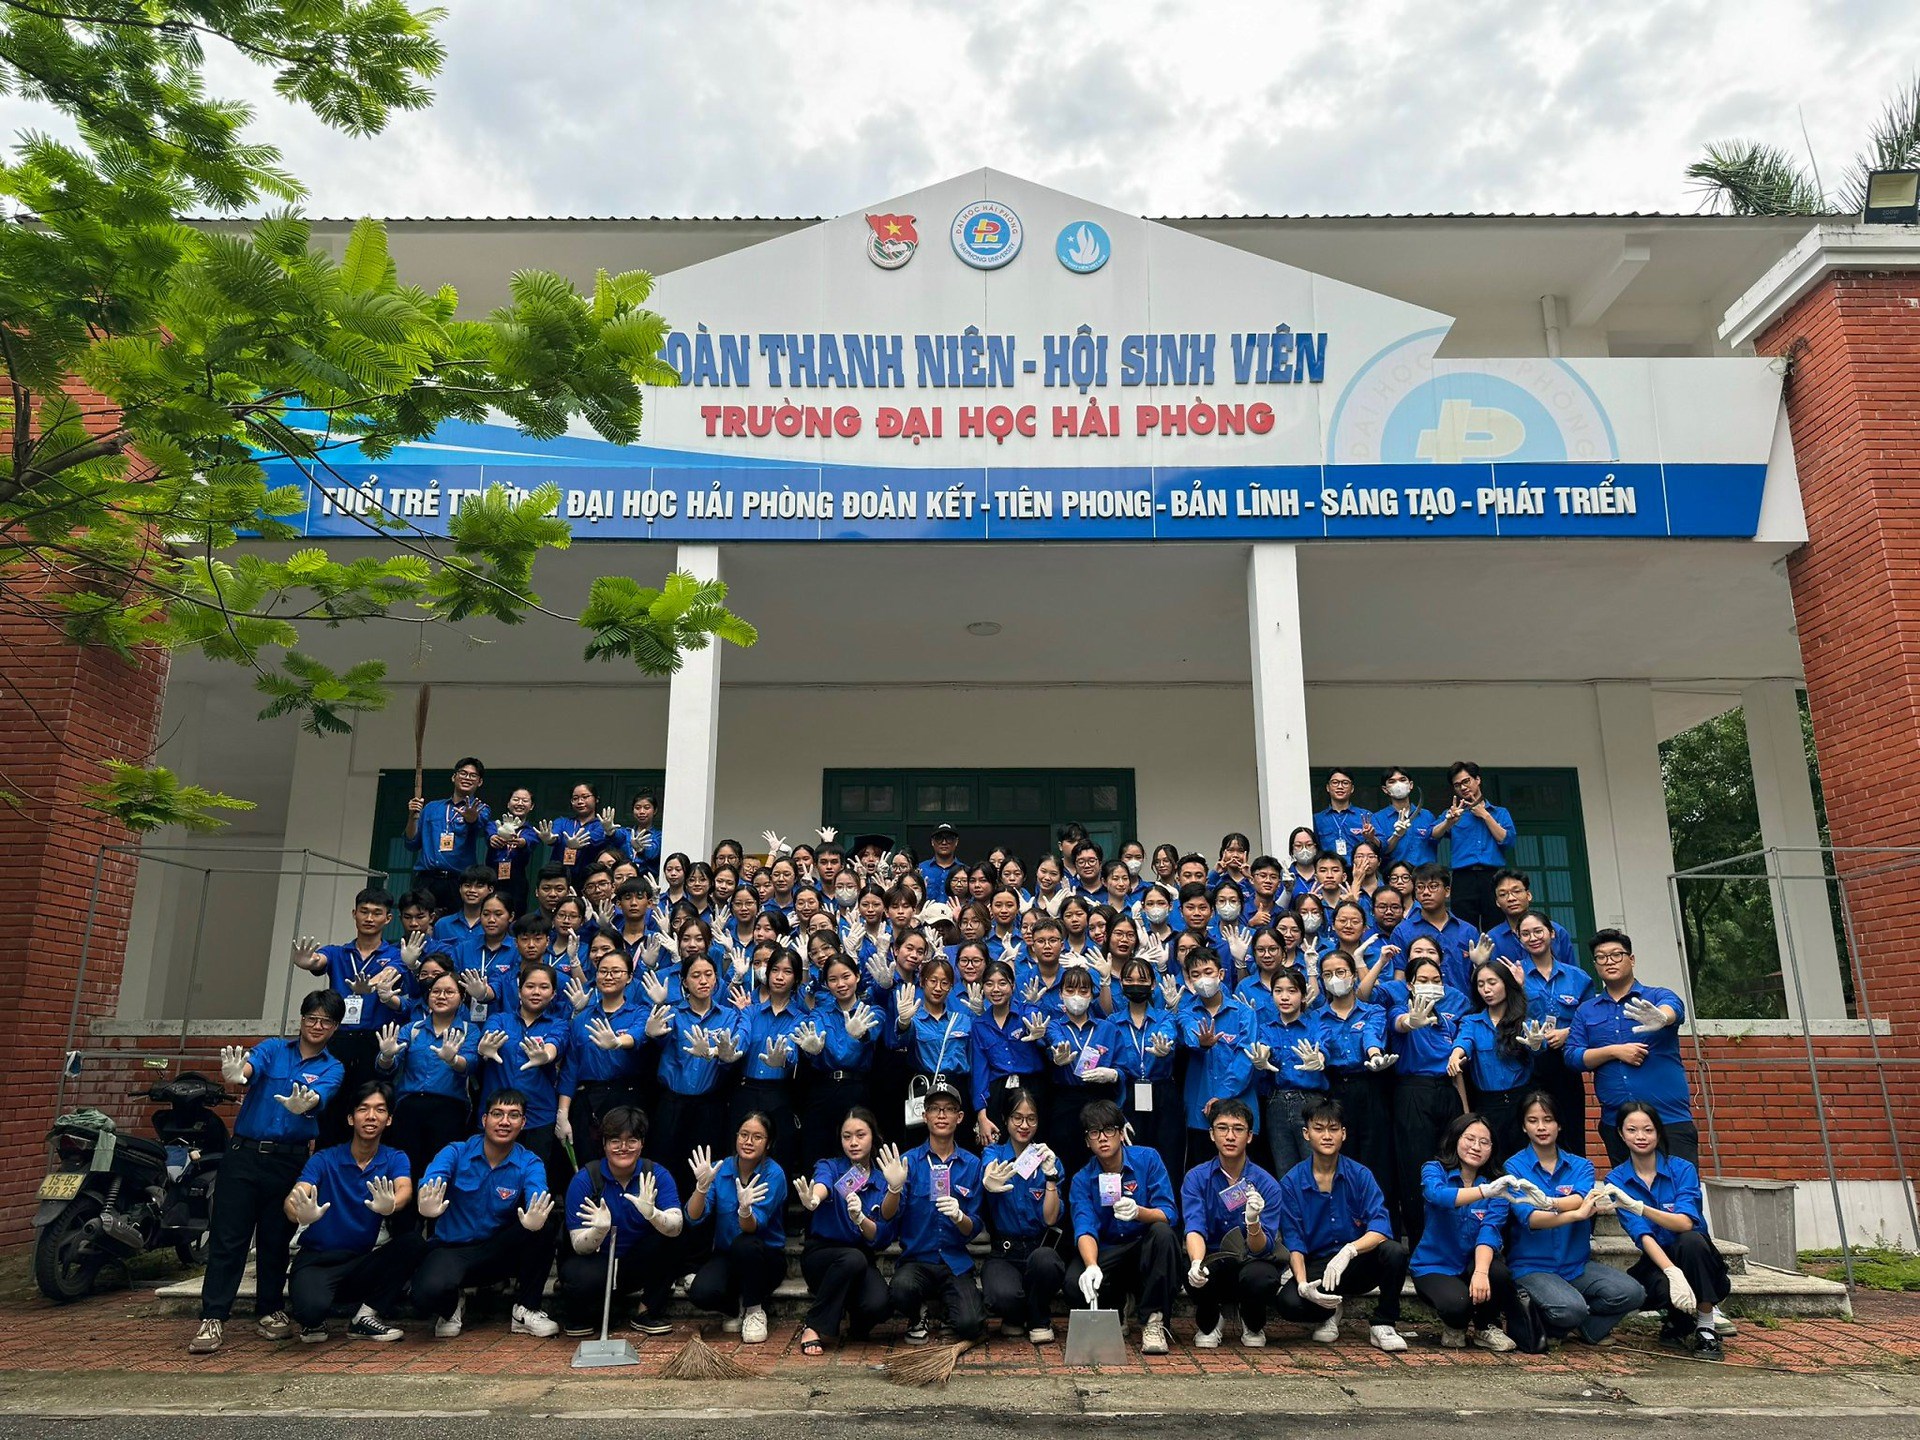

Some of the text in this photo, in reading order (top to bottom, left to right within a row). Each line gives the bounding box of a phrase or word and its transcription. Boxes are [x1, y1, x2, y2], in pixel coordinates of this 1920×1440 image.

[646, 321, 750, 387] OÀN
[759, 333, 905, 388] THANH
[915, 325, 1015, 388] NIÊN
[1043, 323, 1109, 394] HỘI
[1120, 333, 1216, 386] SINH
[1230, 322, 1328, 385] VIÊN
[700, 396, 1276, 445] TRƯỜNG ĐẠI HỌC HẢI PHÒNG
[321, 474, 384, 516] TUỔI
[389, 479, 441, 517] TRẺ
[566, 488, 614, 524] ĐẠI
[622, 489, 677, 523] HỌC
[687, 480, 734, 519] HẢI
[742, 484, 834, 520] PHÒNG
[841, 484, 918, 519] ĐOÀN
[926, 482, 976, 519] KẾT
[994, 485, 1053, 518] TIÊN
[1062, 490, 1152, 519] PHONG
[1170, 480, 1227, 518] BẢN
[1236, 482, 1299, 518] LĨNH
[1321, 482, 1399, 517] SÁNG
[1404, 487, 1457, 521] TẠO
[1476, 480, 1547, 516] PHÁT
[1554, 473, 1637, 516] TRIỂN
